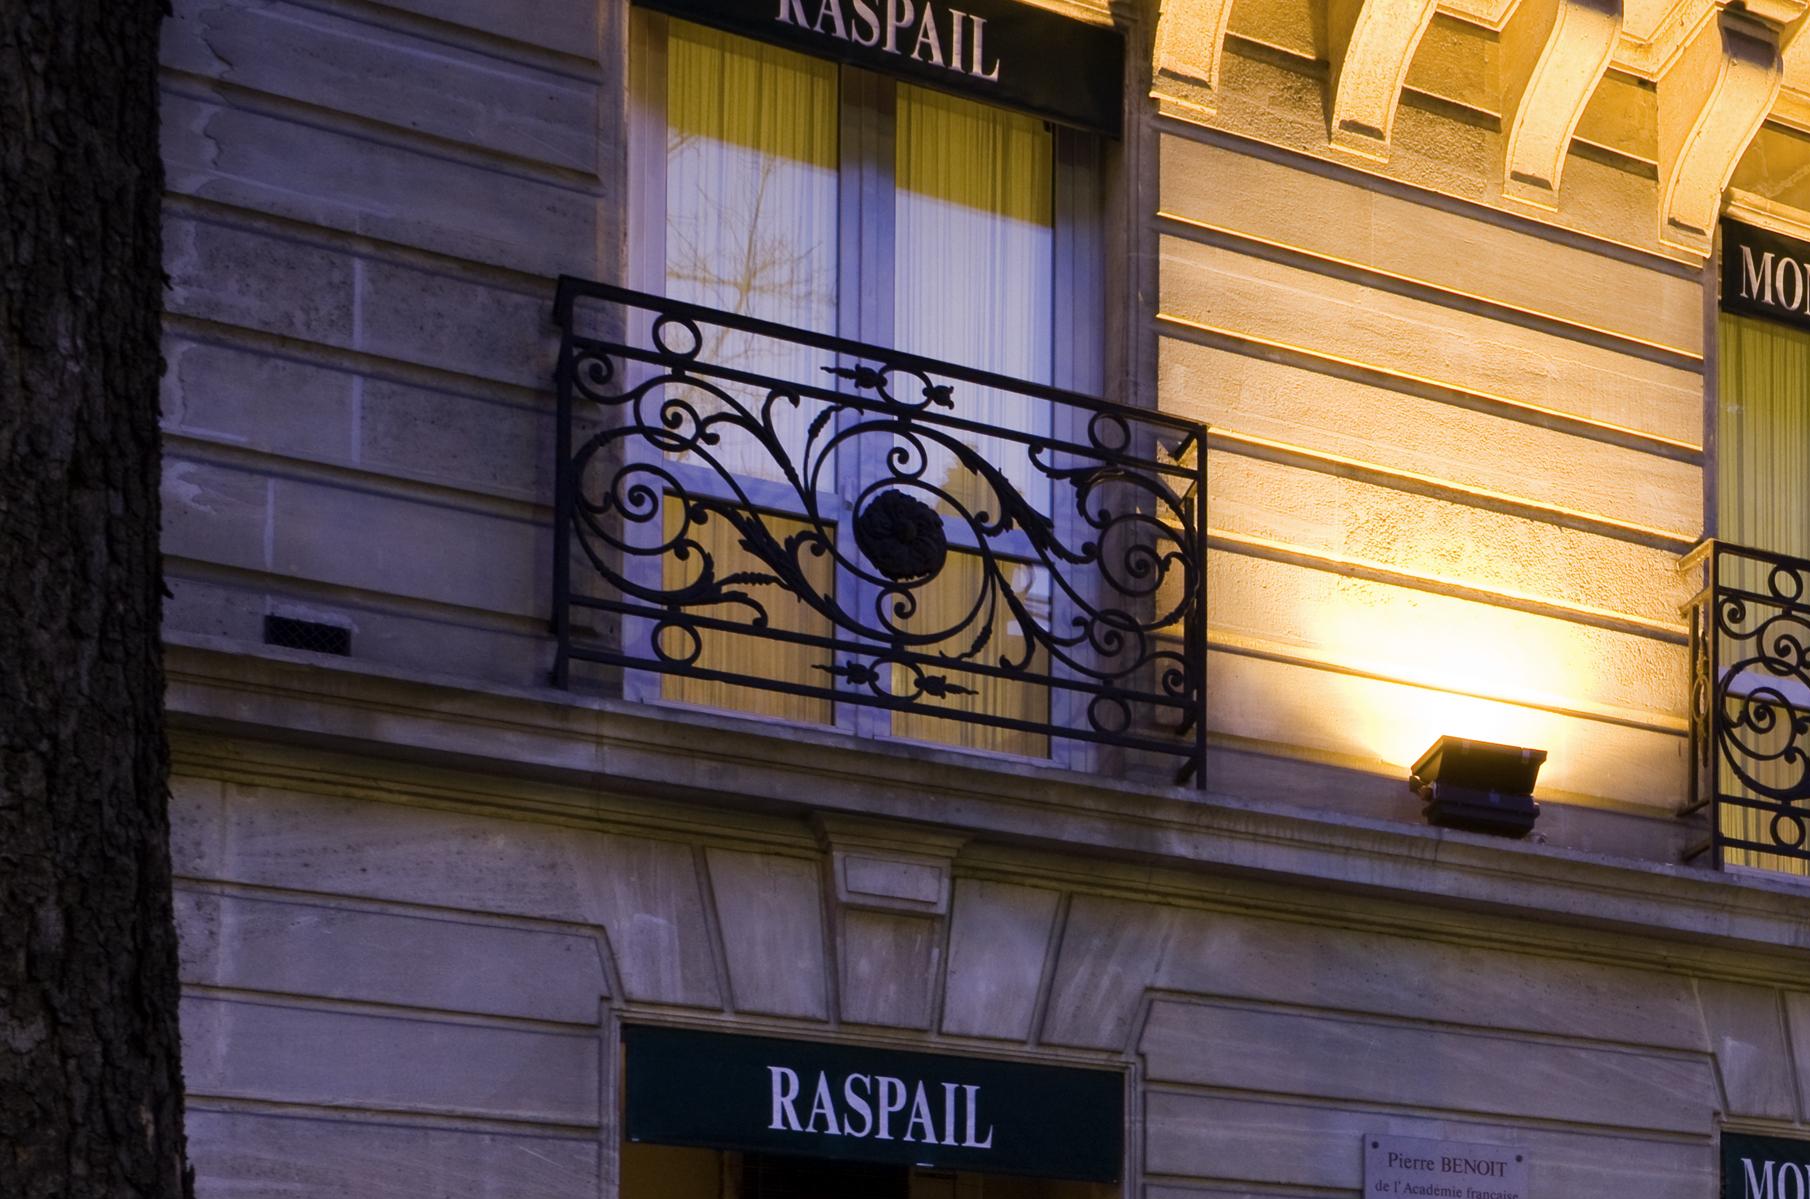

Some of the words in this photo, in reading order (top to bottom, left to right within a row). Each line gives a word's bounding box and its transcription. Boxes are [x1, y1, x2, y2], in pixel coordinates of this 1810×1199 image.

[766, 1065, 993, 1149] RASPAIL
[1387, 1152, 1435, 1171] Pierre
[1441, 1156, 1508, 1177] BENOIT
[1374, 1180, 1390, 1192] de
